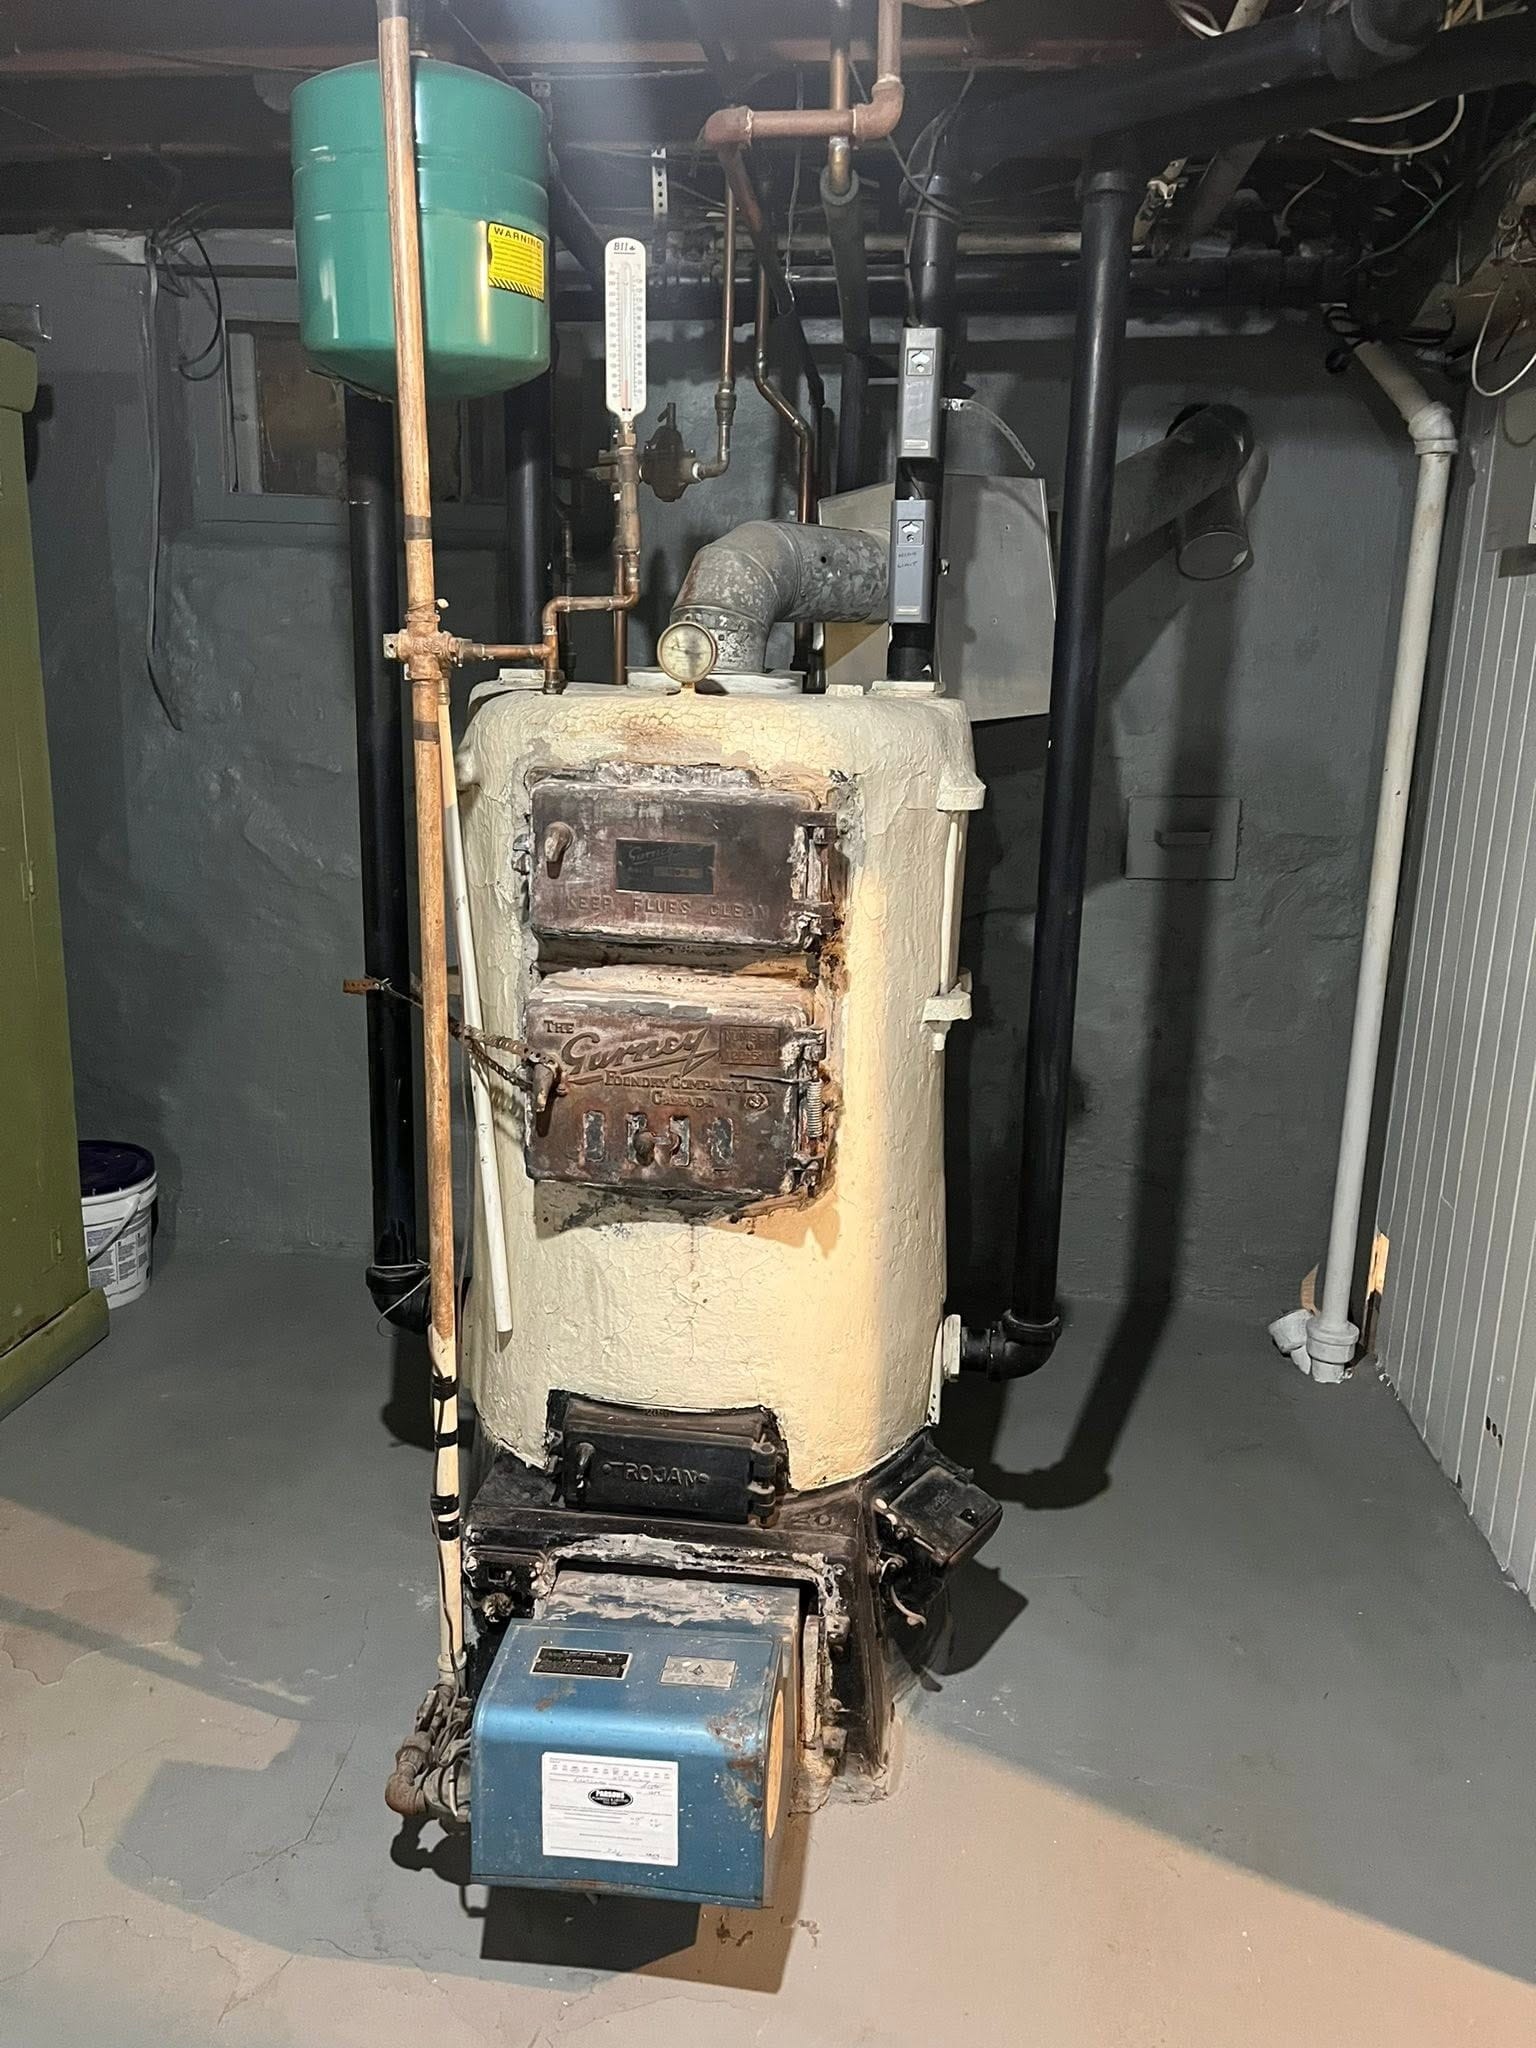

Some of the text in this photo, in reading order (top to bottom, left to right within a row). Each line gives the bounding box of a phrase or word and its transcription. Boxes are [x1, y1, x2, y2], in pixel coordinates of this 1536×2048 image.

[494, 226, 542, 250] WARNING
[565, 895, 770, 920] KEEP FLUES CLEAN
[544, 1020, 575, 1034] THE
[721, 1030, 777, 1044] NUMBER
[561, 1027, 715, 1078] Gurney
[604, 1069, 669, 1088] FOUNDRY
[670, 1073, 743, 1092] COMPANY
[651, 1089, 713, 1108] CANADA
[608, 1462, 699, 1486] TROJAN
